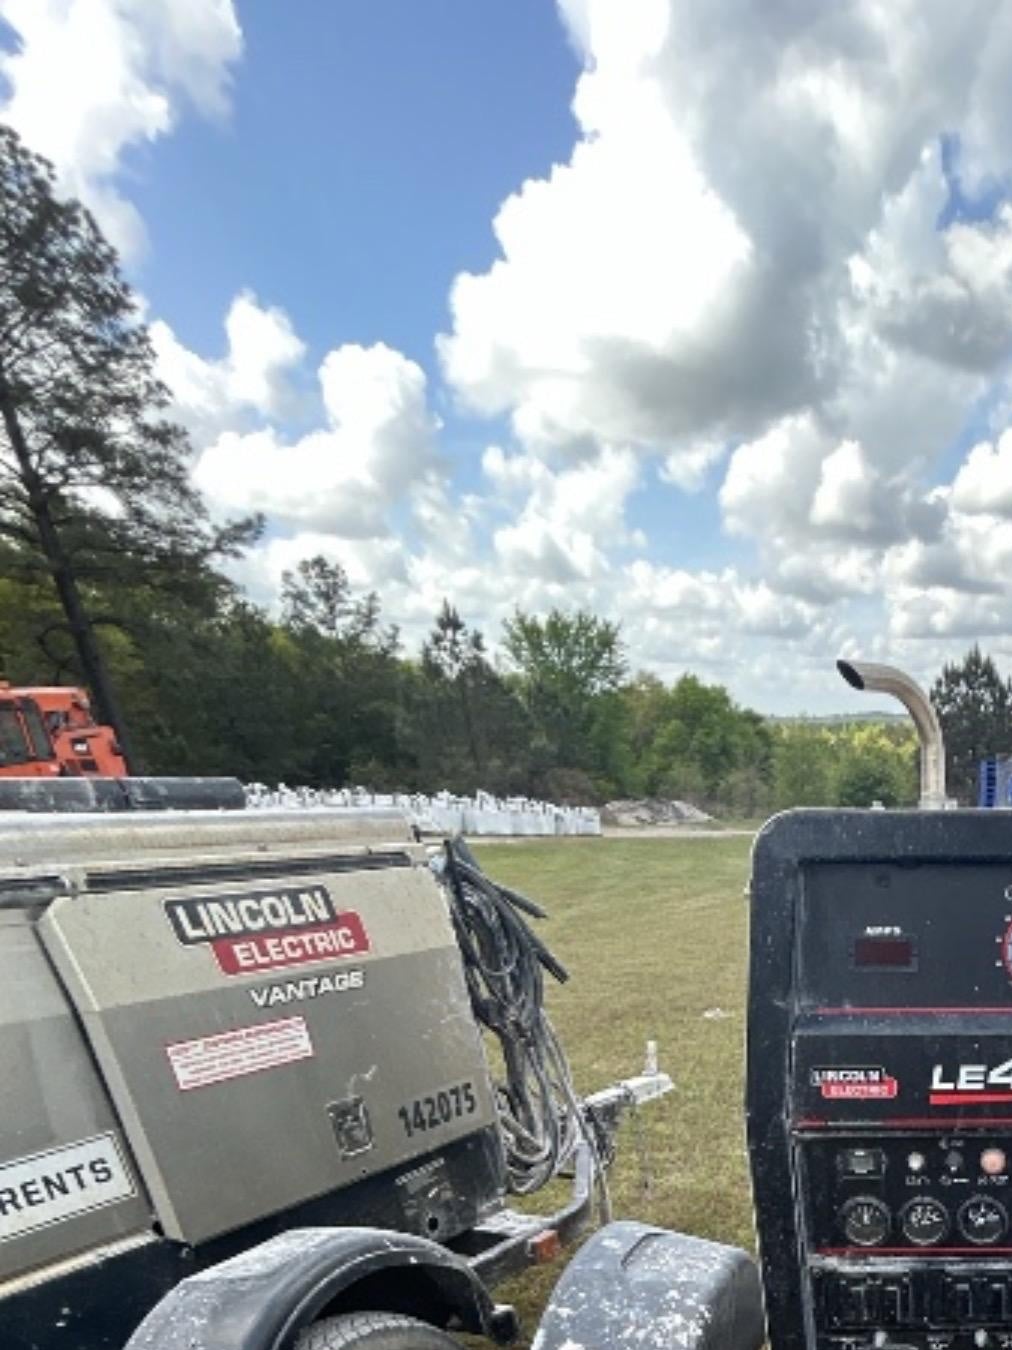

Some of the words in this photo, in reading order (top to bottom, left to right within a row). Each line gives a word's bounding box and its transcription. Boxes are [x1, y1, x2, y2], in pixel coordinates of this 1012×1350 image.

[175, 890, 331, 940] LINCOLN
[232, 927, 356, 968] ELECTRIC
[249, 970, 365, 1007] VANTAGE
[398, 1082, 477, 1138] 142075
[0, 1157, 113, 1216] RENTS
